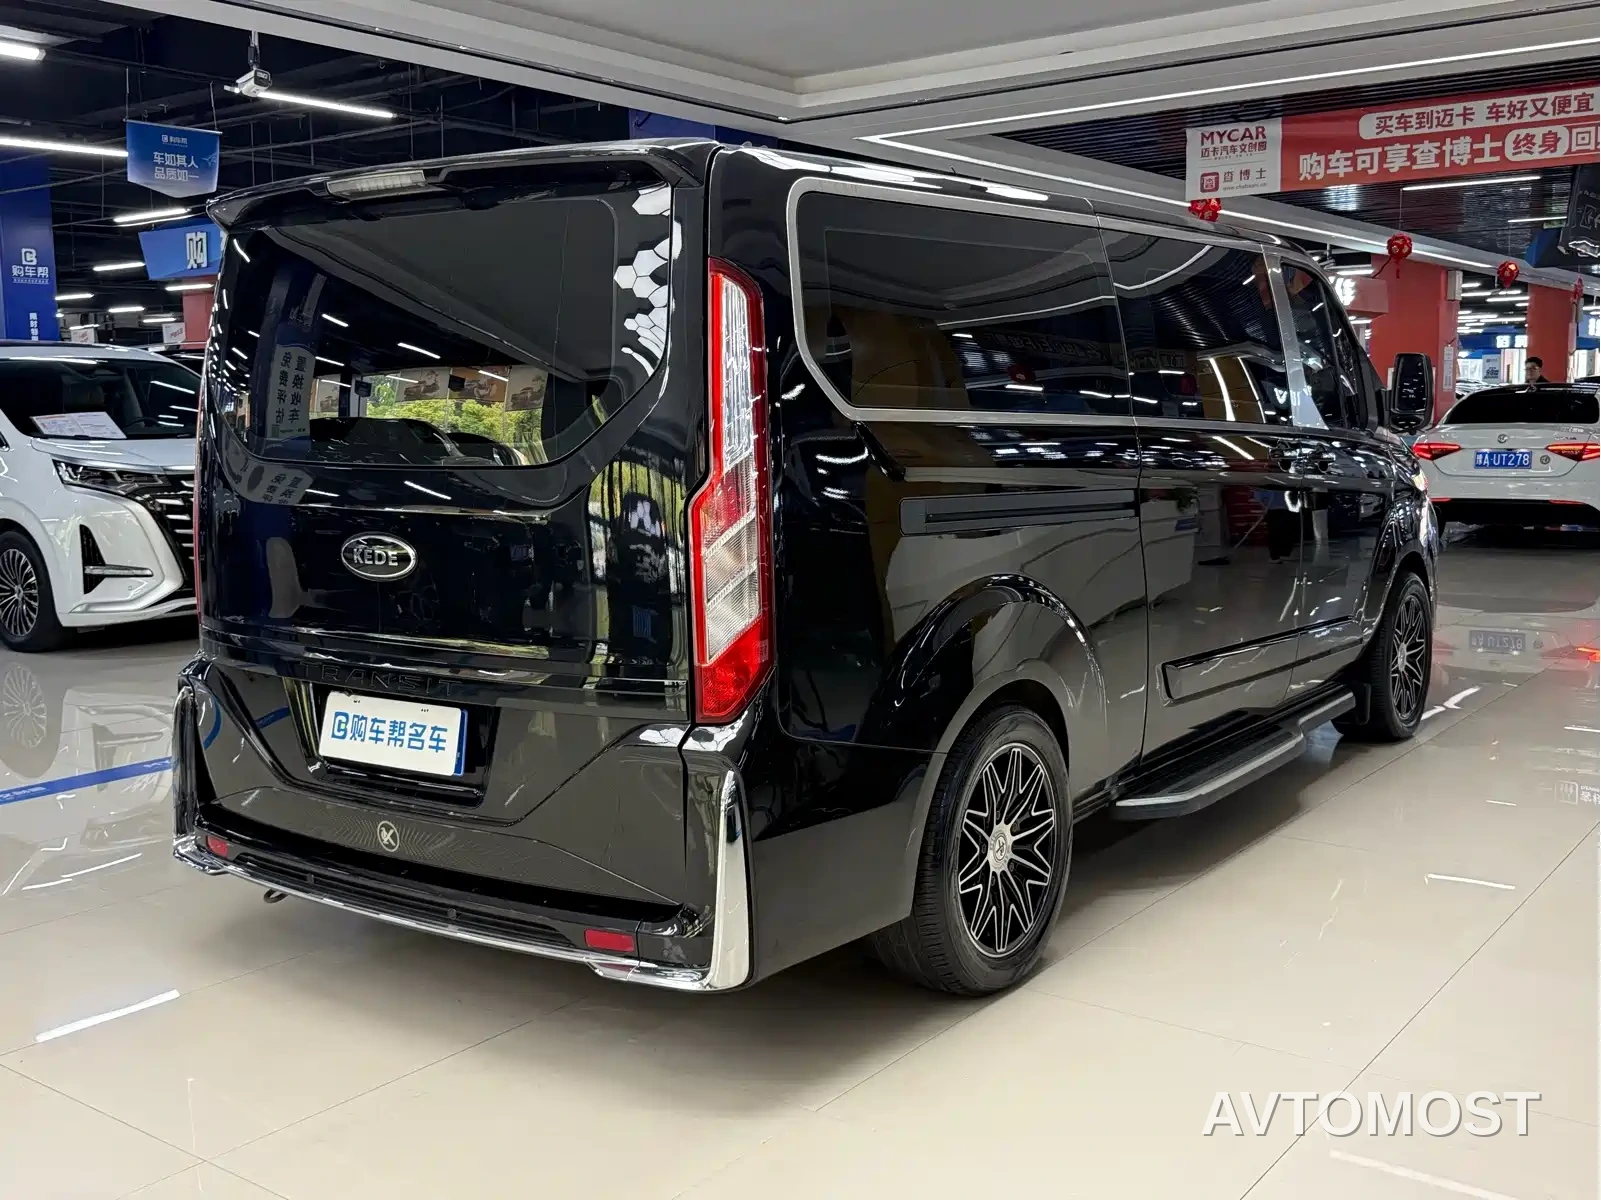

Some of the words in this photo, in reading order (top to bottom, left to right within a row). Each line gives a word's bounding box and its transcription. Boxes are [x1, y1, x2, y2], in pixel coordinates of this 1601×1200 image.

[1375, 106, 1476, 135] 买车到迈卡
[1485, 92, 1594, 122] 车好又便宜
[1200, 126, 1267, 146] MYCAR
[153, 151, 199, 169] 车如其人
[154, 166, 200, 182] 品质如一
[11, 265, 49, 279] 购车帮
[353, 547, 399, 567] KEDE
[302, 660, 463, 697] TRANSIT
[350, 712, 448, 753] 购车帮名车
